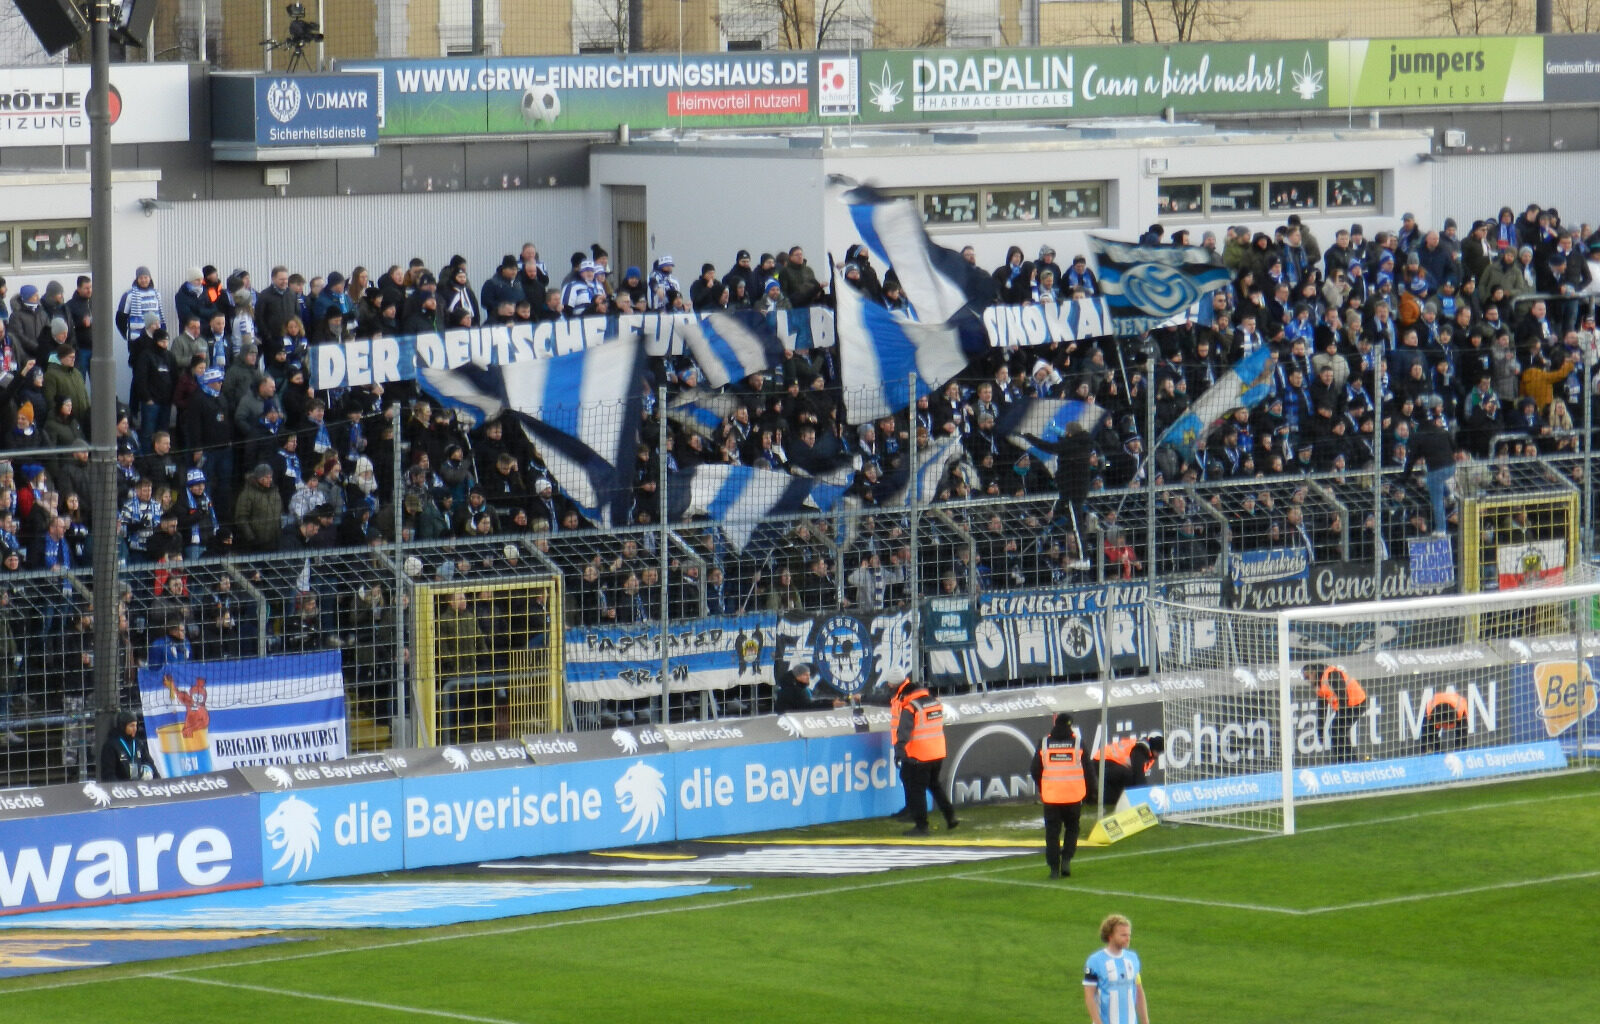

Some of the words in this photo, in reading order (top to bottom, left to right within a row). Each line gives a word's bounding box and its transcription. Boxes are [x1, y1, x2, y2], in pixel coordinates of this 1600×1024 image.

[913, 56, 1074, 93] DRAPALIN
[1389, 45, 1486, 82] jumpers
[1546, 62, 1584, 74] Gemeinsam
[396, 61, 808, 93] WWW.GRW-EINRICHTUNGSHAUS.DE
[1081, 63, 1138, 101] Cann
[1144, 75, 1160, 95] a
[1213, 53, 1284, 95] mehr!
[306, 90, 368, 109] VDMAYR
[677, 93, 750, 111] Heimvorteil
[754, 93, 801, 109] nutzen!
[918, 94, 1069, 109] PHARMACEUTICALS
[1388, 84, 1486, 101] FITNESS
[269, 126, 367, 140] Sicherheitsdienste
[318, 337, 400, 390] DER
[416, 316, 607, 370] DEUTSCHE
[1110, 686, 1134, 698] die
[960, 703, 983, 716] die
[984, 694, 1057, 714] Bayerische
[1399, 681, 1497, 742] MN
[804, 715, 827, 729] die
[216, 735, 270, 757] BRIGADE
[271, 727, 339, 752] BOCKWURST
[640, 729, 664, 745] die
[664, 726, 744, 743] Bayerische
[470, 747, 496, 763] die
[495, 738, 578, 760] Bayerische
[1465, 756, 1484, 769] die
[1486, 749, 1545, 768] Bayerische
[294, 767, 320, 781] die
[319, 756, 407, 779] Bayerische
[1321, 772, 1340, 786] die
[1342, 765, 1407, 784] Bayerische
[111, 786, 138, 799] die
[142, 776, 228, 798] Bayerische
[680, 767, 734, 810] die
[956, 774, 1036, 803] MAN
[1172, 788, 1193, 803] die
[1192, 780, 1259, 801] Bayerische
[334, 801, 392, 847] die
[406, 782, 602, 842] Bayerische
